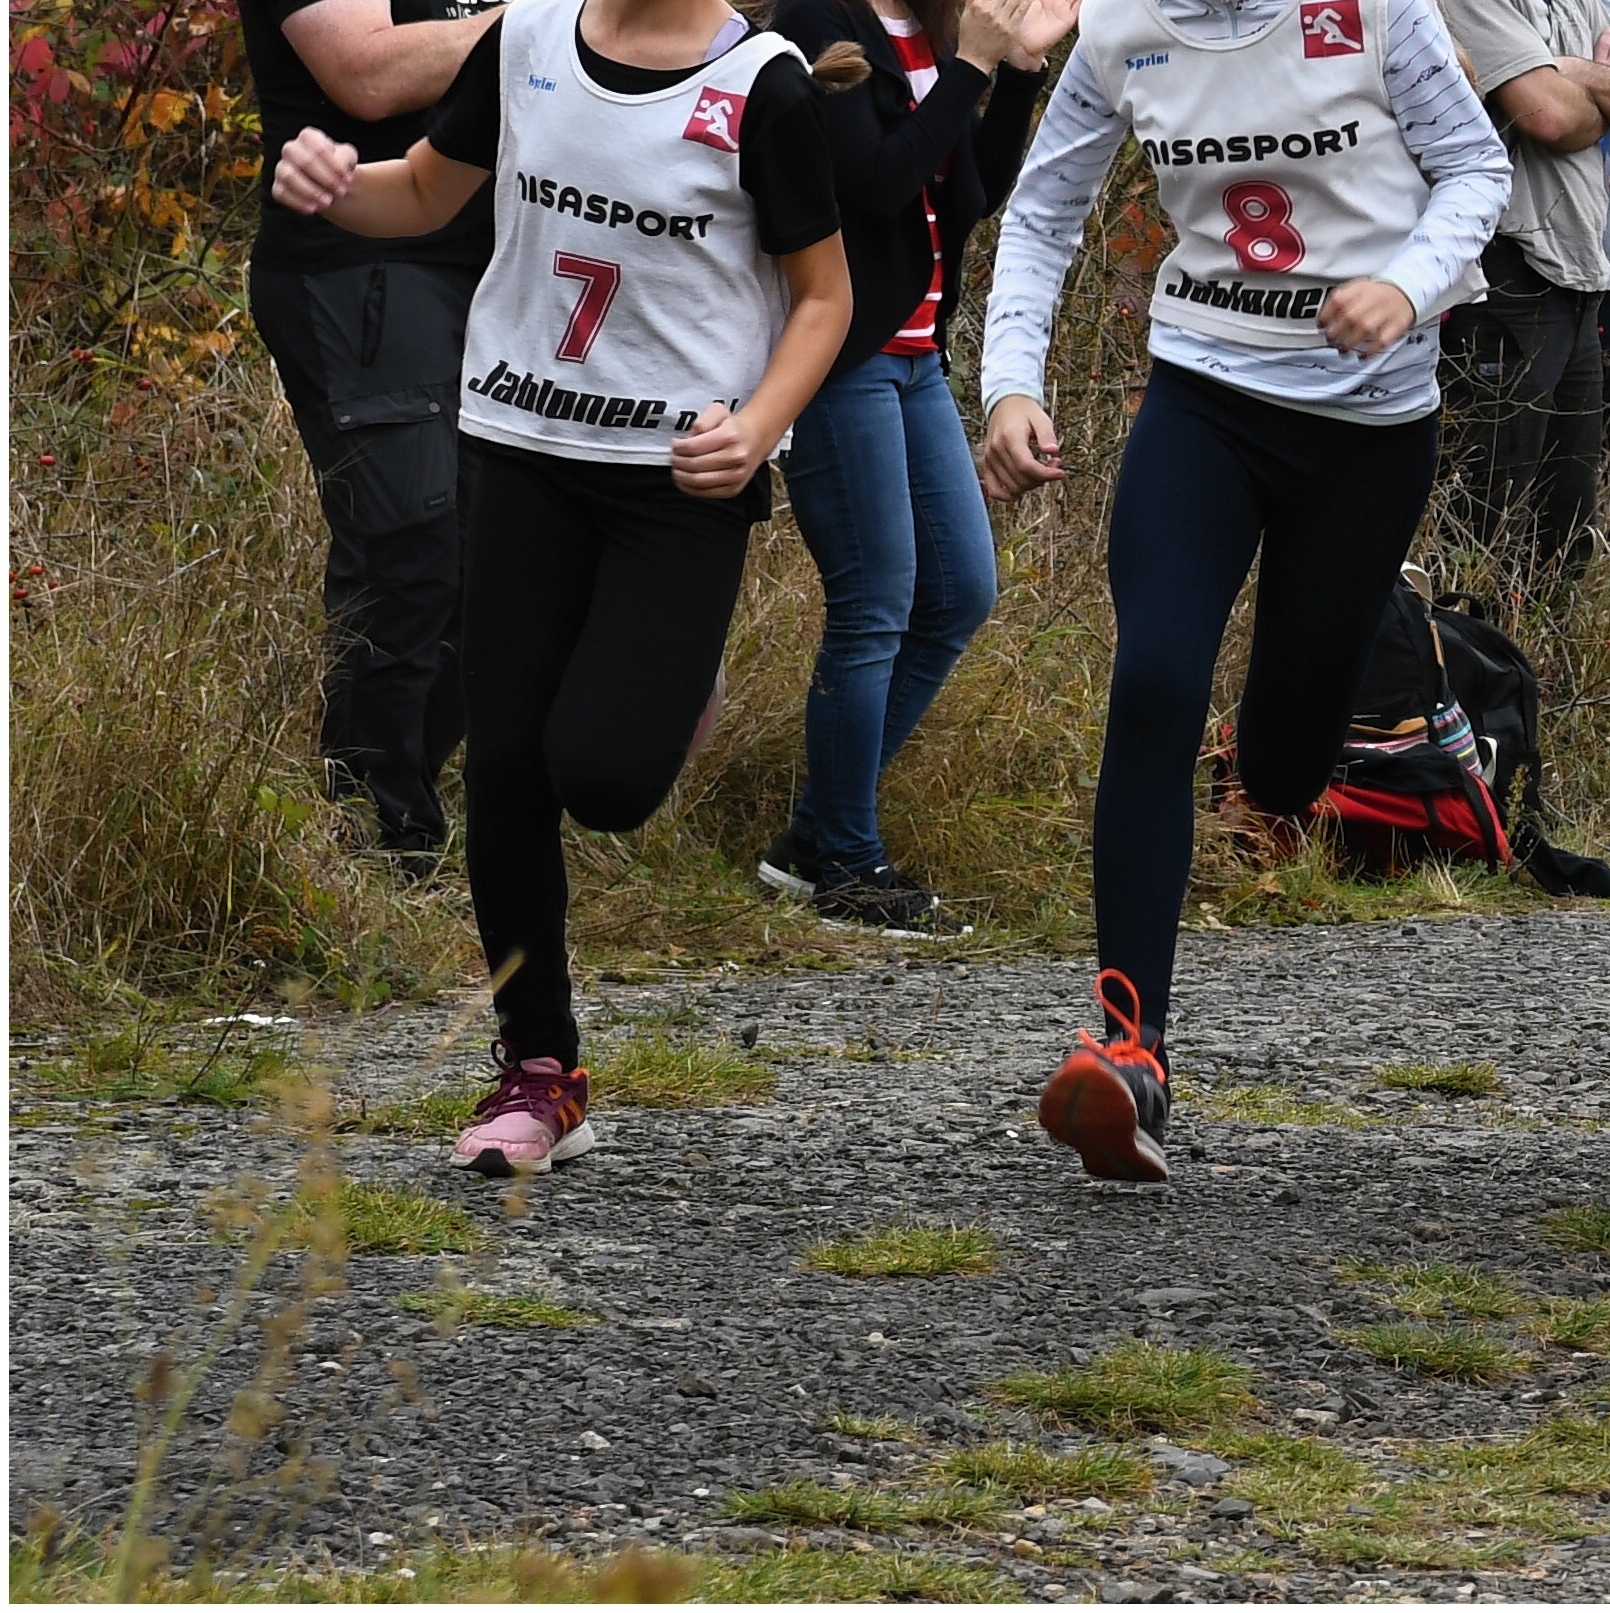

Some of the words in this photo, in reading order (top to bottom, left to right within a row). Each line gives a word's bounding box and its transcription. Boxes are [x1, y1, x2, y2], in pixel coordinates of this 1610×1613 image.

[1222, 179, 1307, 274] 8
[552, 249, 622, 365] 7
[1165, 267, 1332, 319] Jablone
